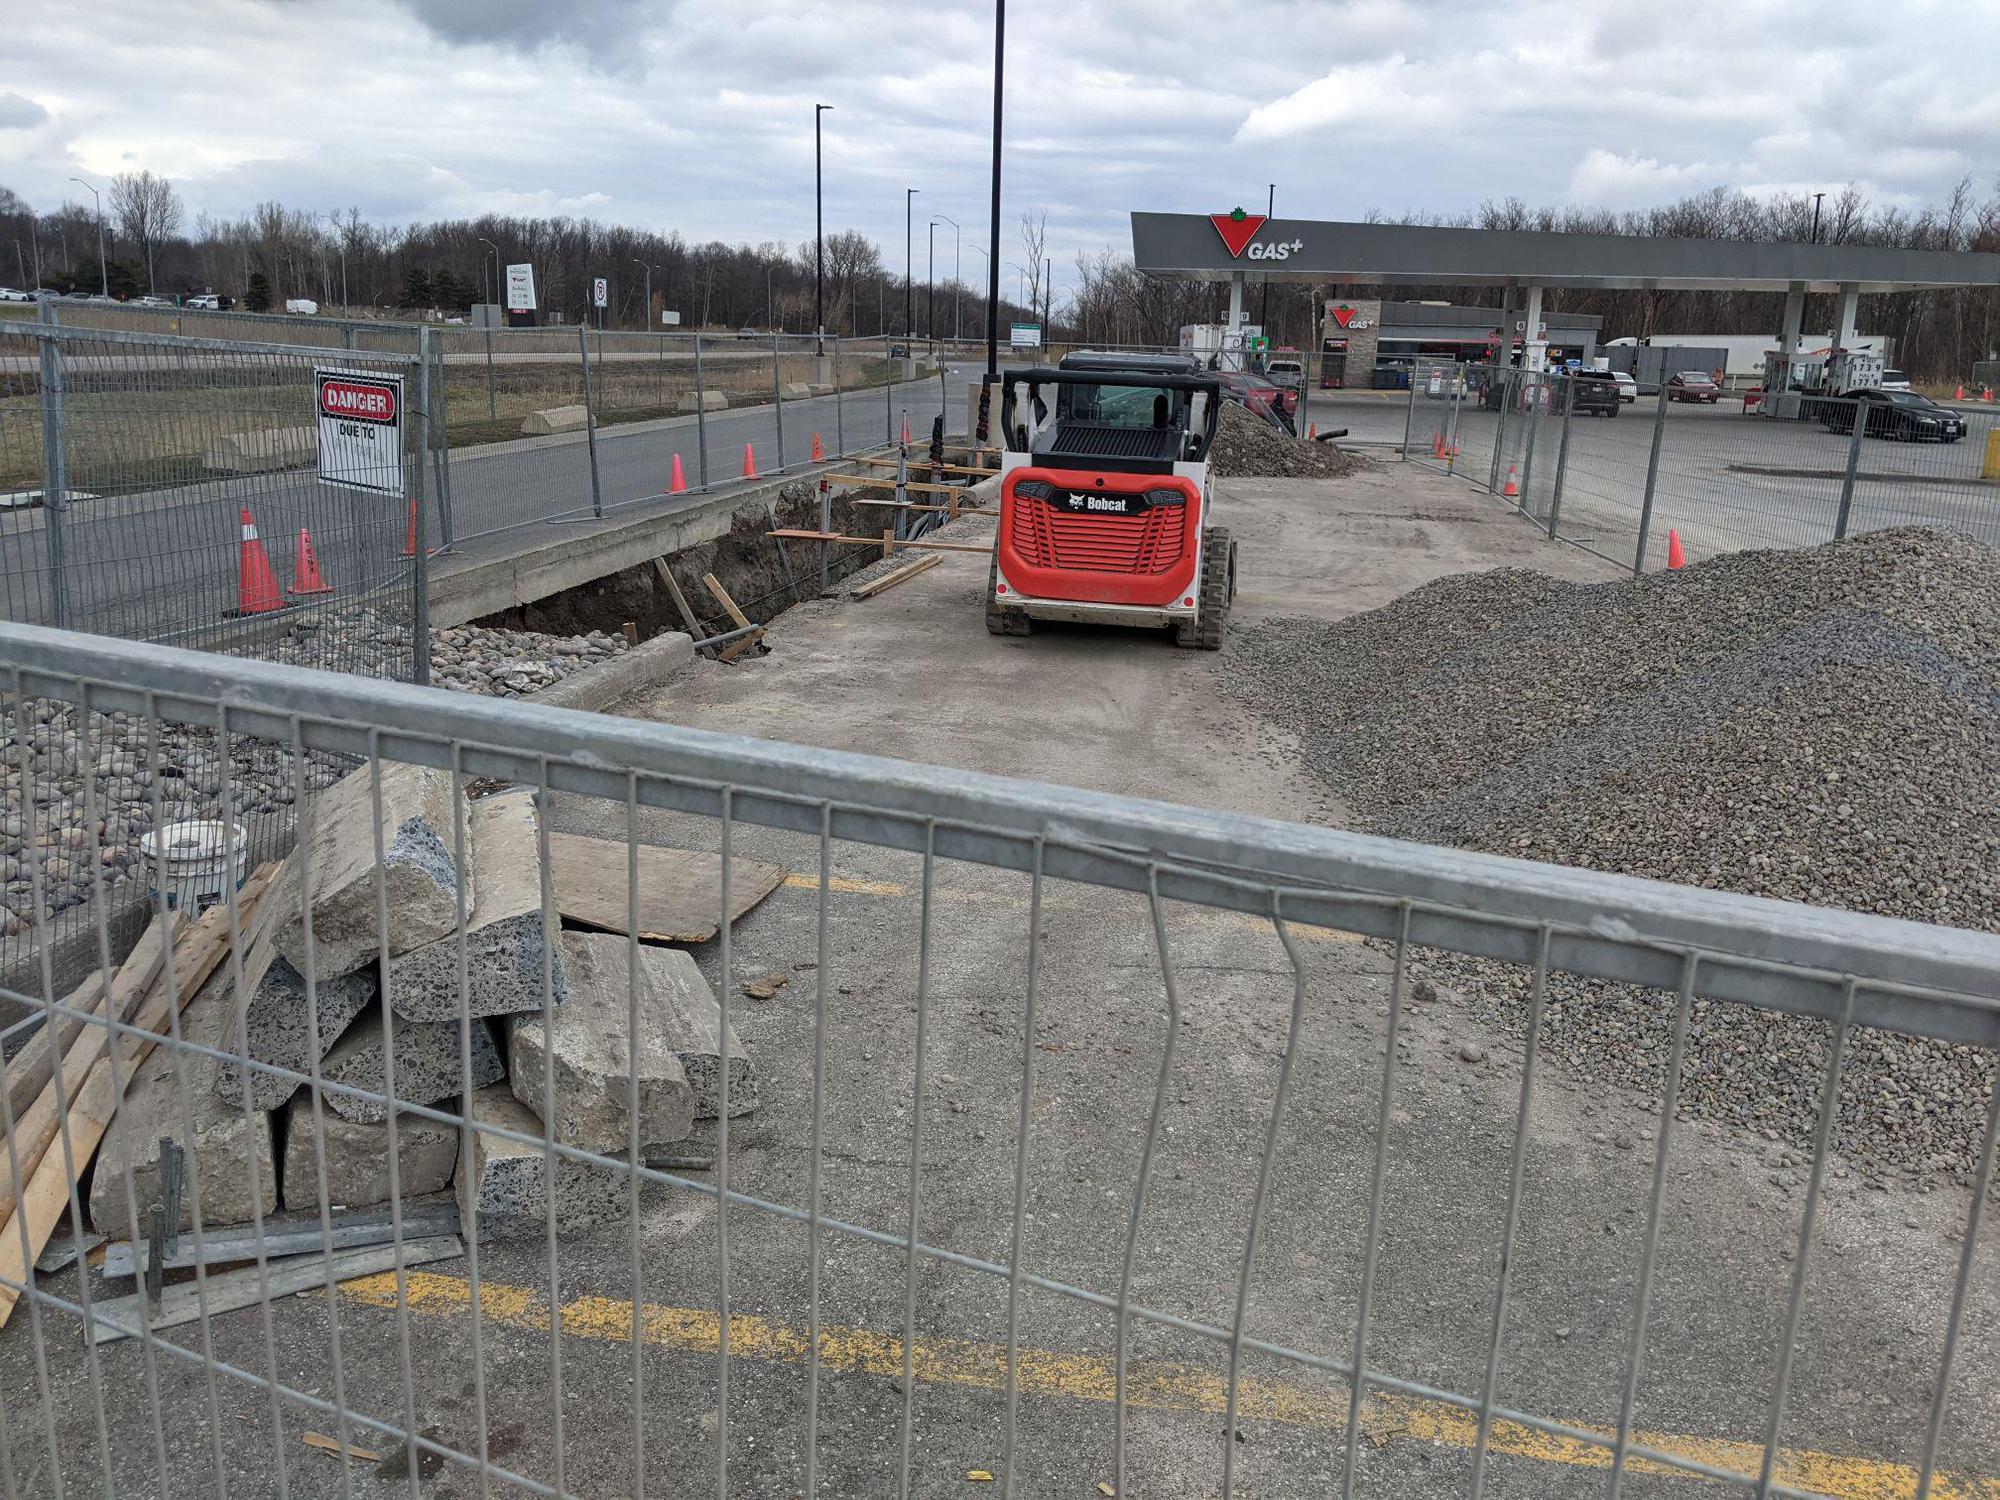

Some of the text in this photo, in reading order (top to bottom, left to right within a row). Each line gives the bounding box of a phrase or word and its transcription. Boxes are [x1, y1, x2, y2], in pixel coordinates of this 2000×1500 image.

[1829, 330, 1836, 338] 2
[327, 389, 387, 413] DANGER
[340, 424, 375, 440] DUE TO
[1087, 496, 1127, 512] Bobcat
